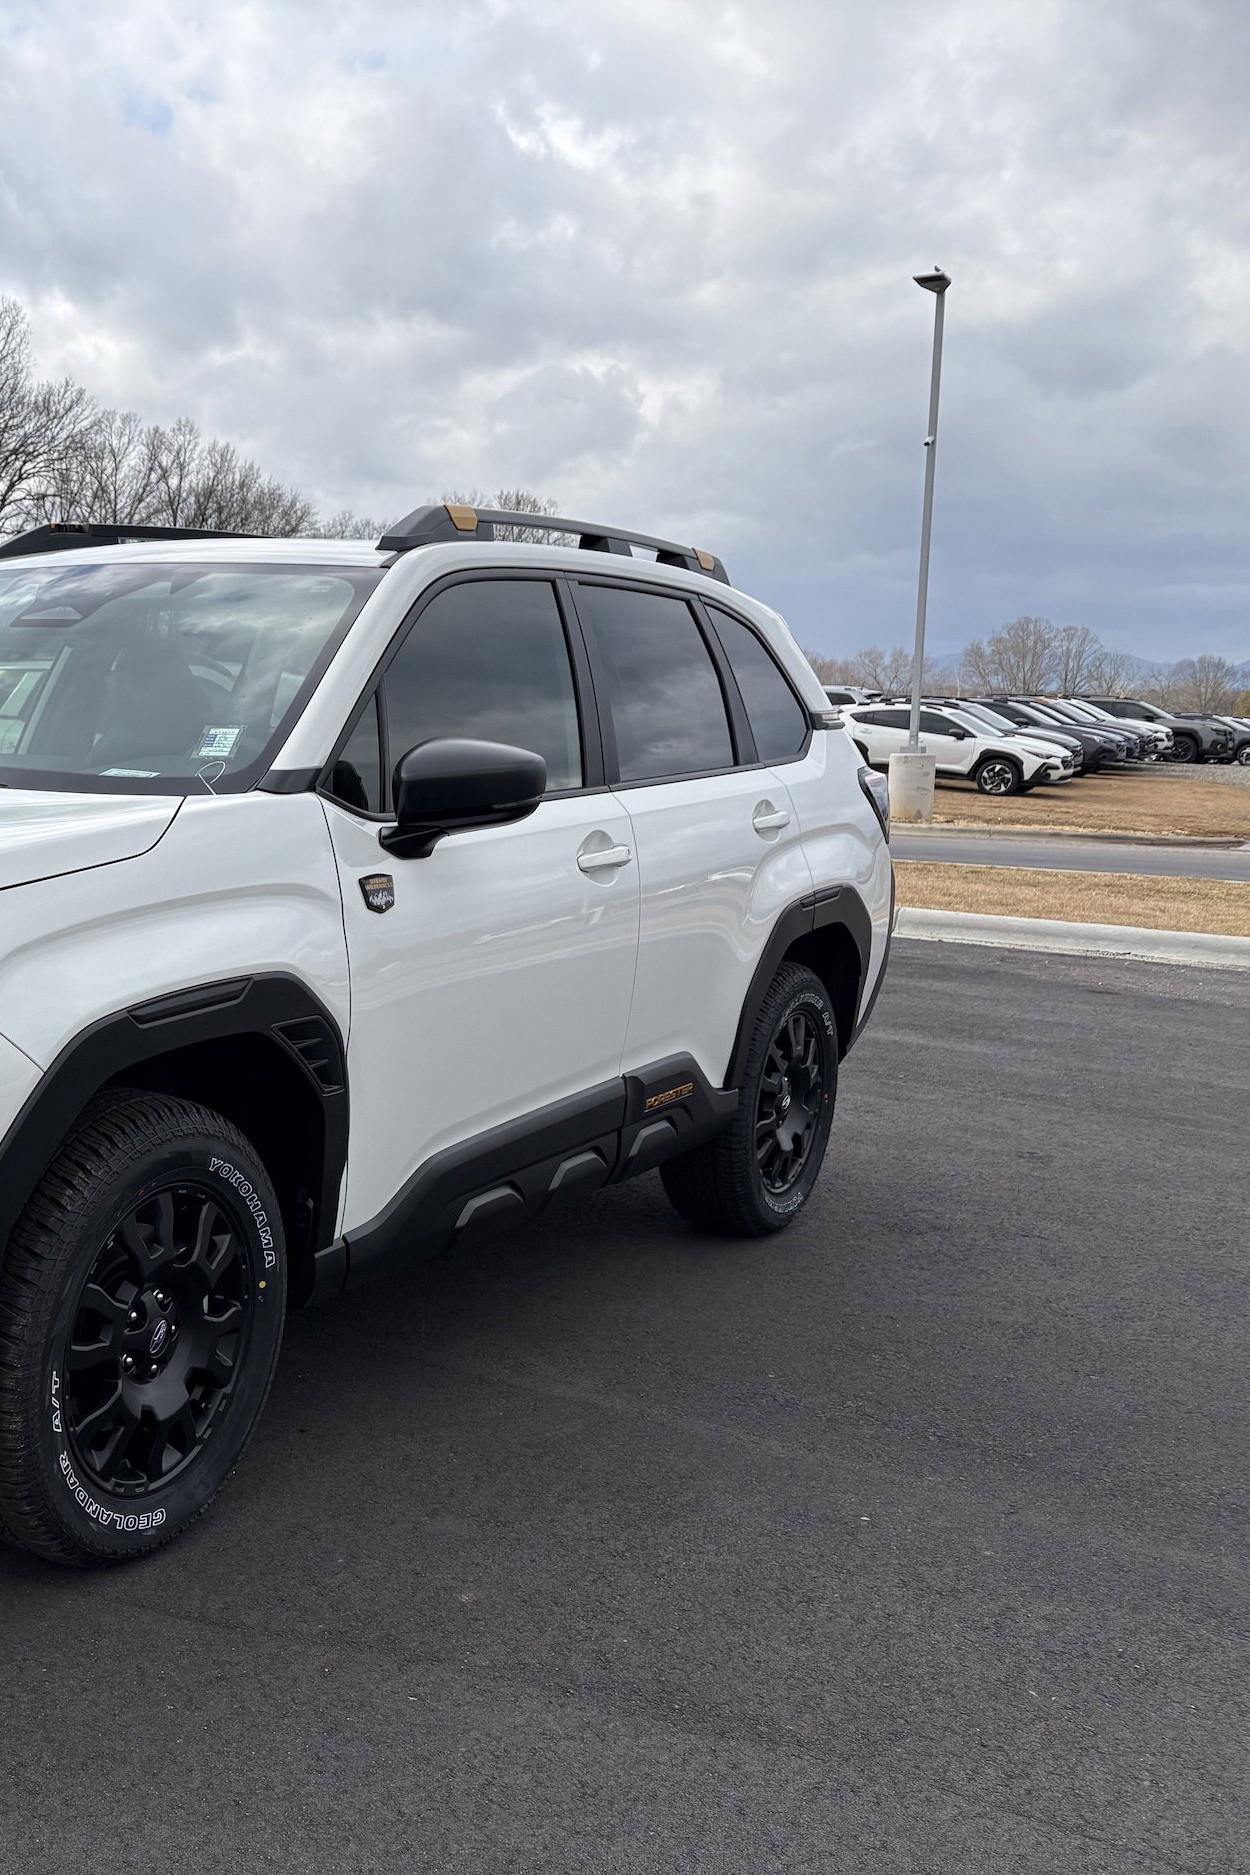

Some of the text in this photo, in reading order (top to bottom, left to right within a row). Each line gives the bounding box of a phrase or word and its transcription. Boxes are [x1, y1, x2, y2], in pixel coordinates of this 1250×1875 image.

[645, 1082, 694, 1110] FORESTER
[209, 1157, 276, 1269] YOKOHAMA
[51, 1370, 166, 1531] GEOLANDAR A/T
